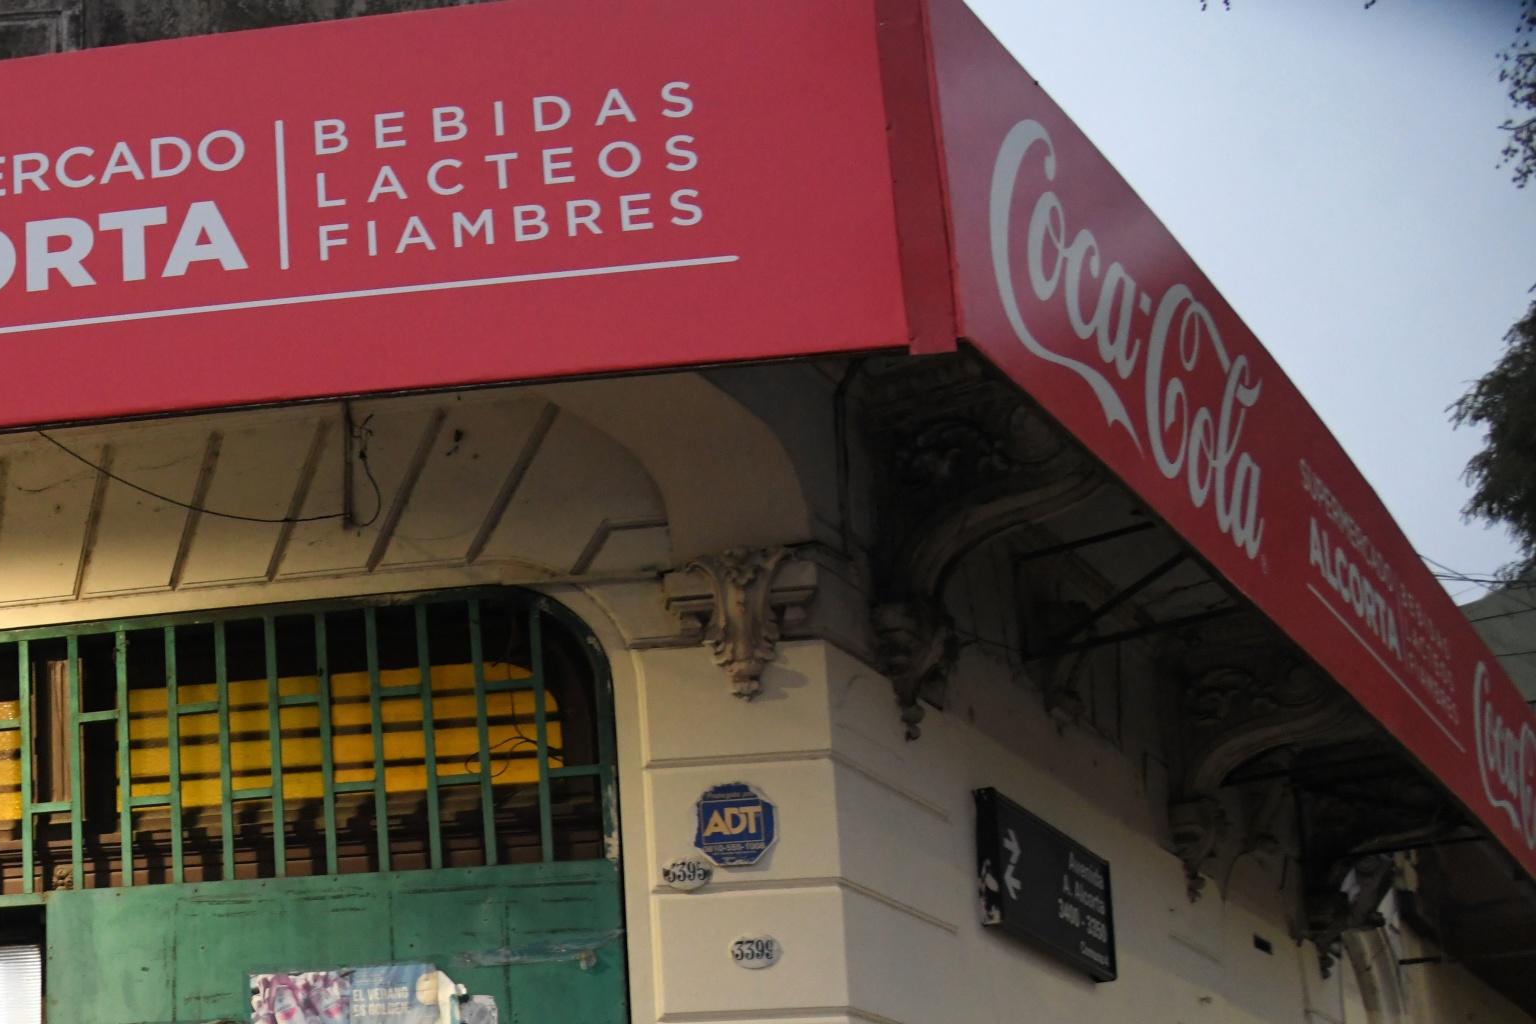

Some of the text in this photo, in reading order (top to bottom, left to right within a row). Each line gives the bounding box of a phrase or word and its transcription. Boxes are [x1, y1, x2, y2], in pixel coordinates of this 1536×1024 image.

[313, 80, 695, 156] BEBIDAS
[315, 134, 700, 209] LACTEOS
[317, 187, 704, 262] FIAMBRES
[989, 118, 1262, 560] Coca-Cola
[1309, 516, 1402, 662] ALCORTA
[703, 805, 762, 837] ADT
[734, 939, 773, 961] 3399
